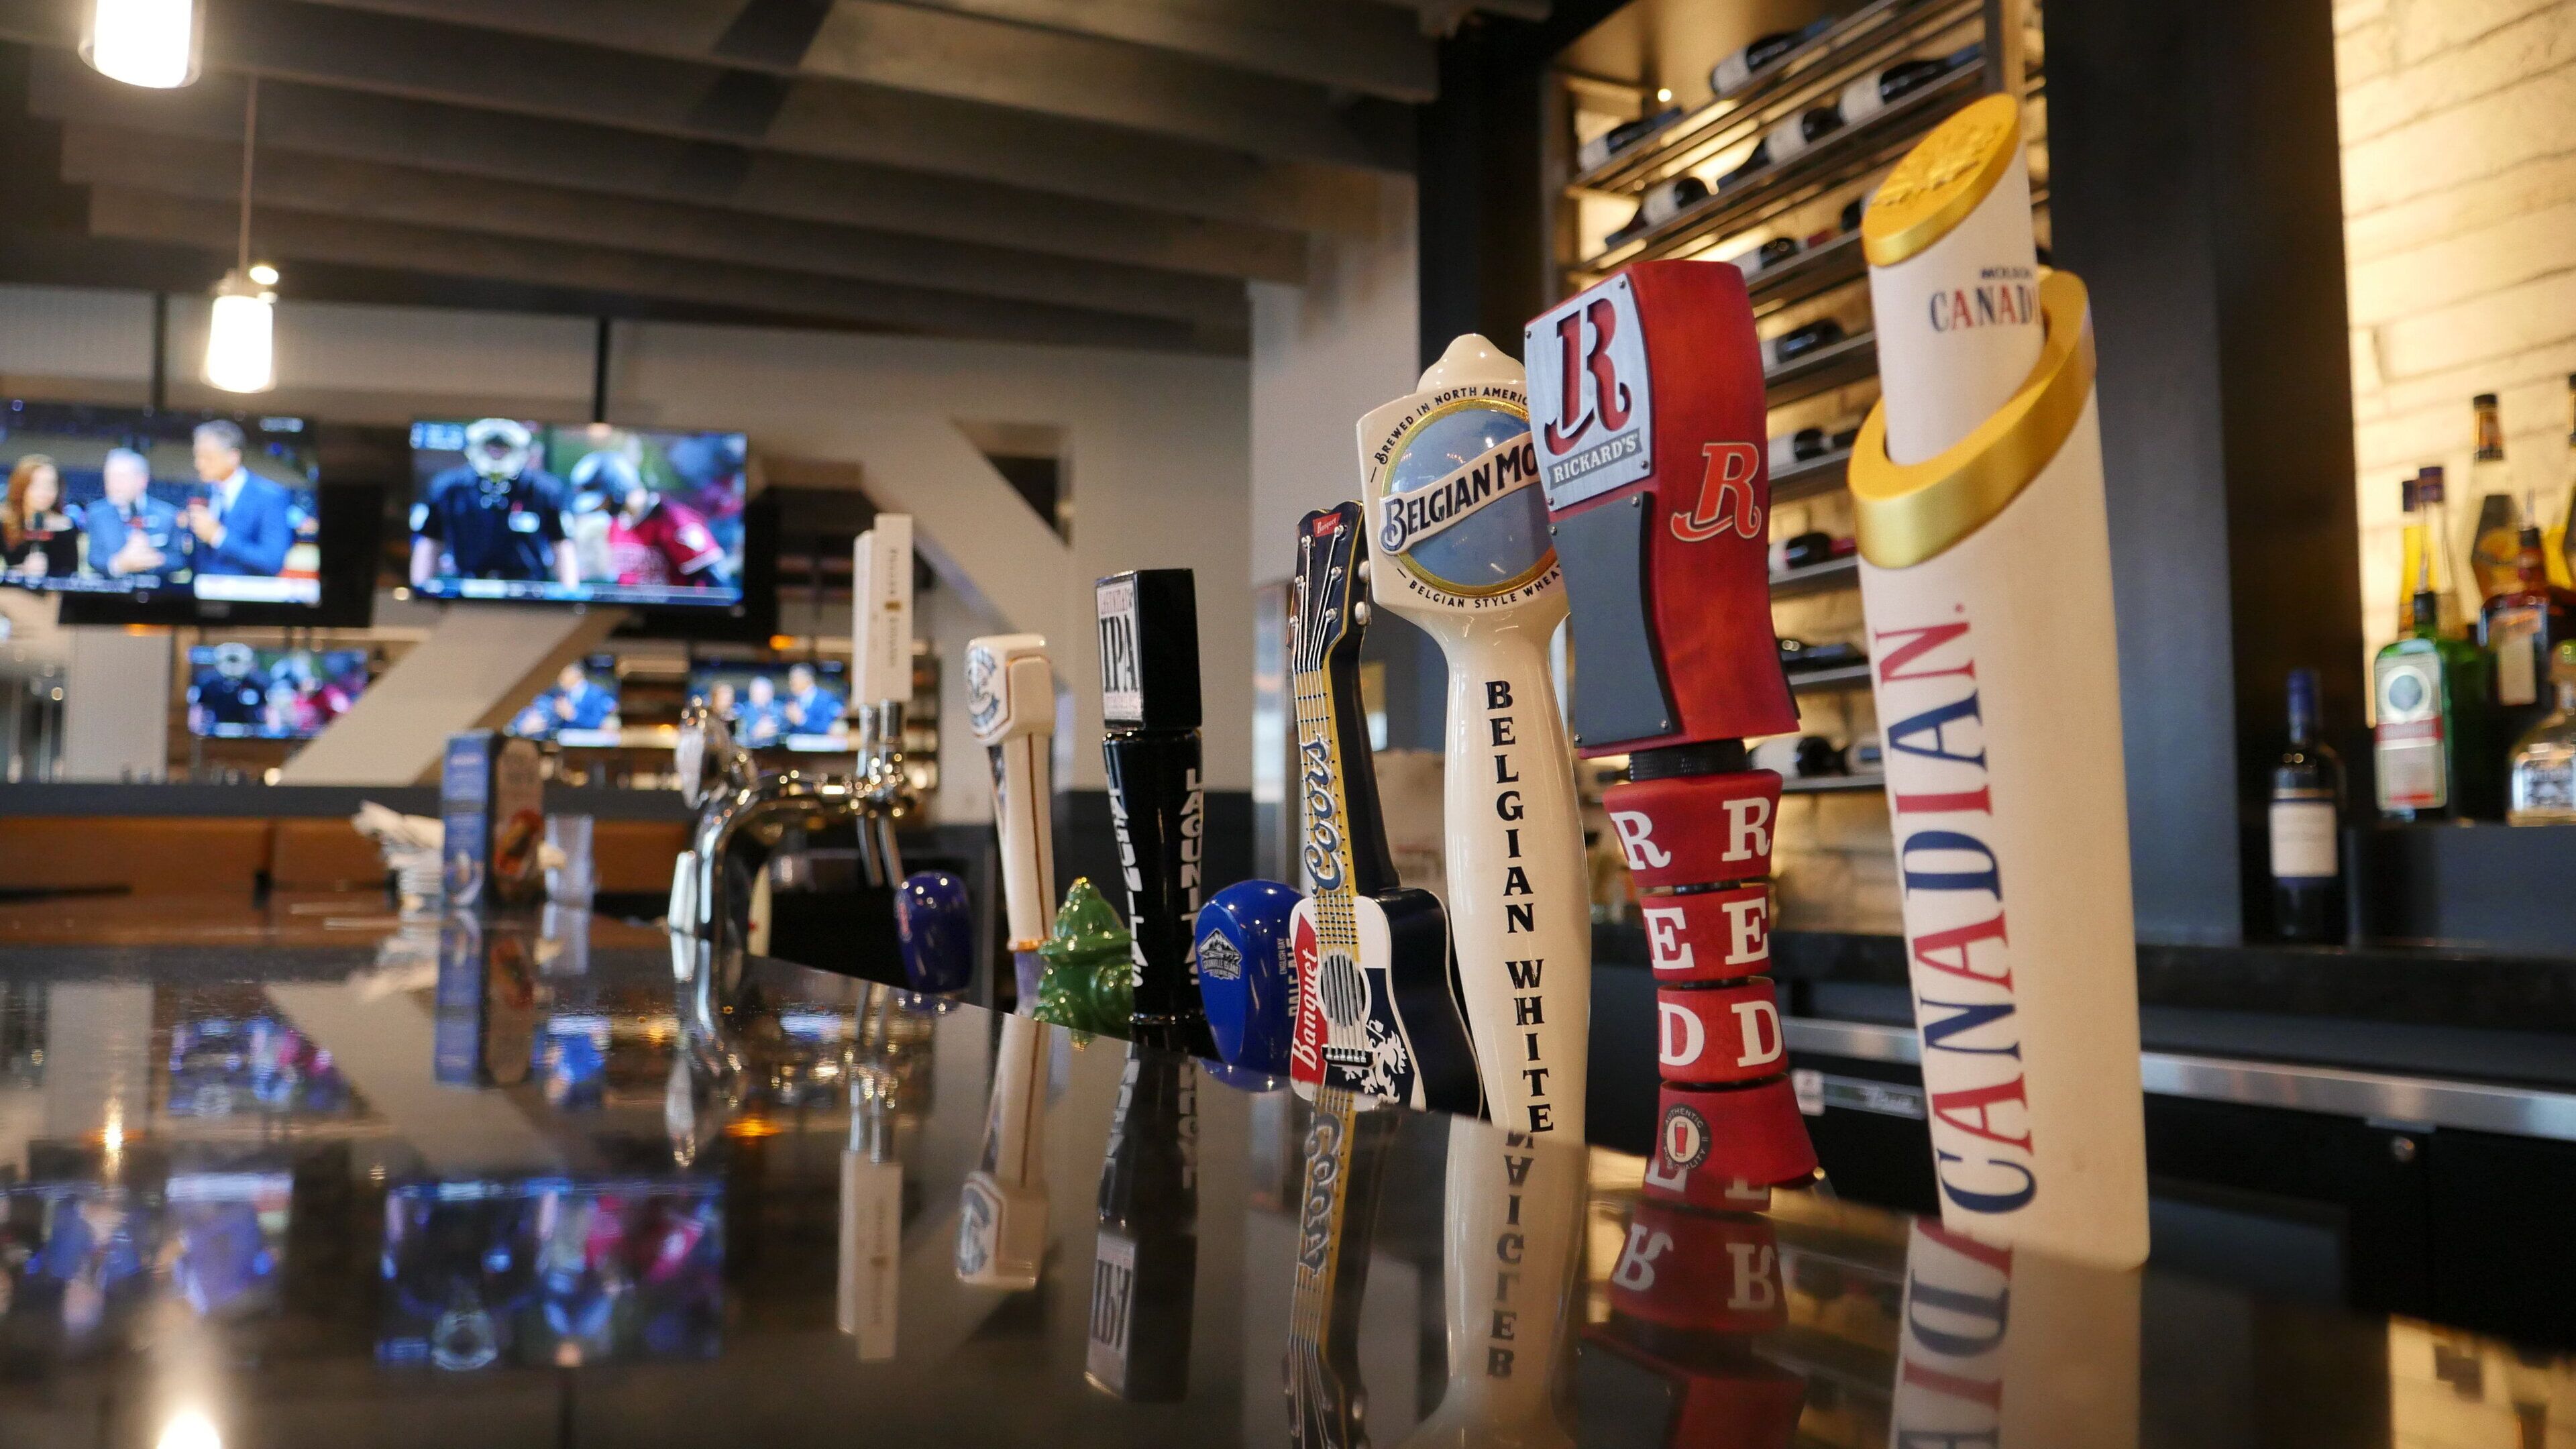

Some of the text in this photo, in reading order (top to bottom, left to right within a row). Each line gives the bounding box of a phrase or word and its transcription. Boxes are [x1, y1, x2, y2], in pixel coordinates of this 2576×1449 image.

[1544, 298, 1632, 455] R
[1375, 415, 1414, 464] BREWED
[1417, 402, 1430, 417] IN
[1434, 386, 1477, 405] NORTH
[1552, 432, 1638, 484] RICKARD'S
[1380, 462, 1491, 551] BELGIAN
[1670, 441, 1762, 542] R
[1409, 580, 1465, 608] BELGIAN
[1474, 593, 1517, 608] STYLE
[1100, 613, 1138, 694] IPA
[1301, 733, 1346, 896] Coors
[1485, 680, 1554, 1133] BELGIAN WHITE
[1874, 620, 2037, 1215] CANADIAN
[1293, 947, 1318, 1071] Banquet
[1665, 1108, 1704, 1128] AUTHENTIC
